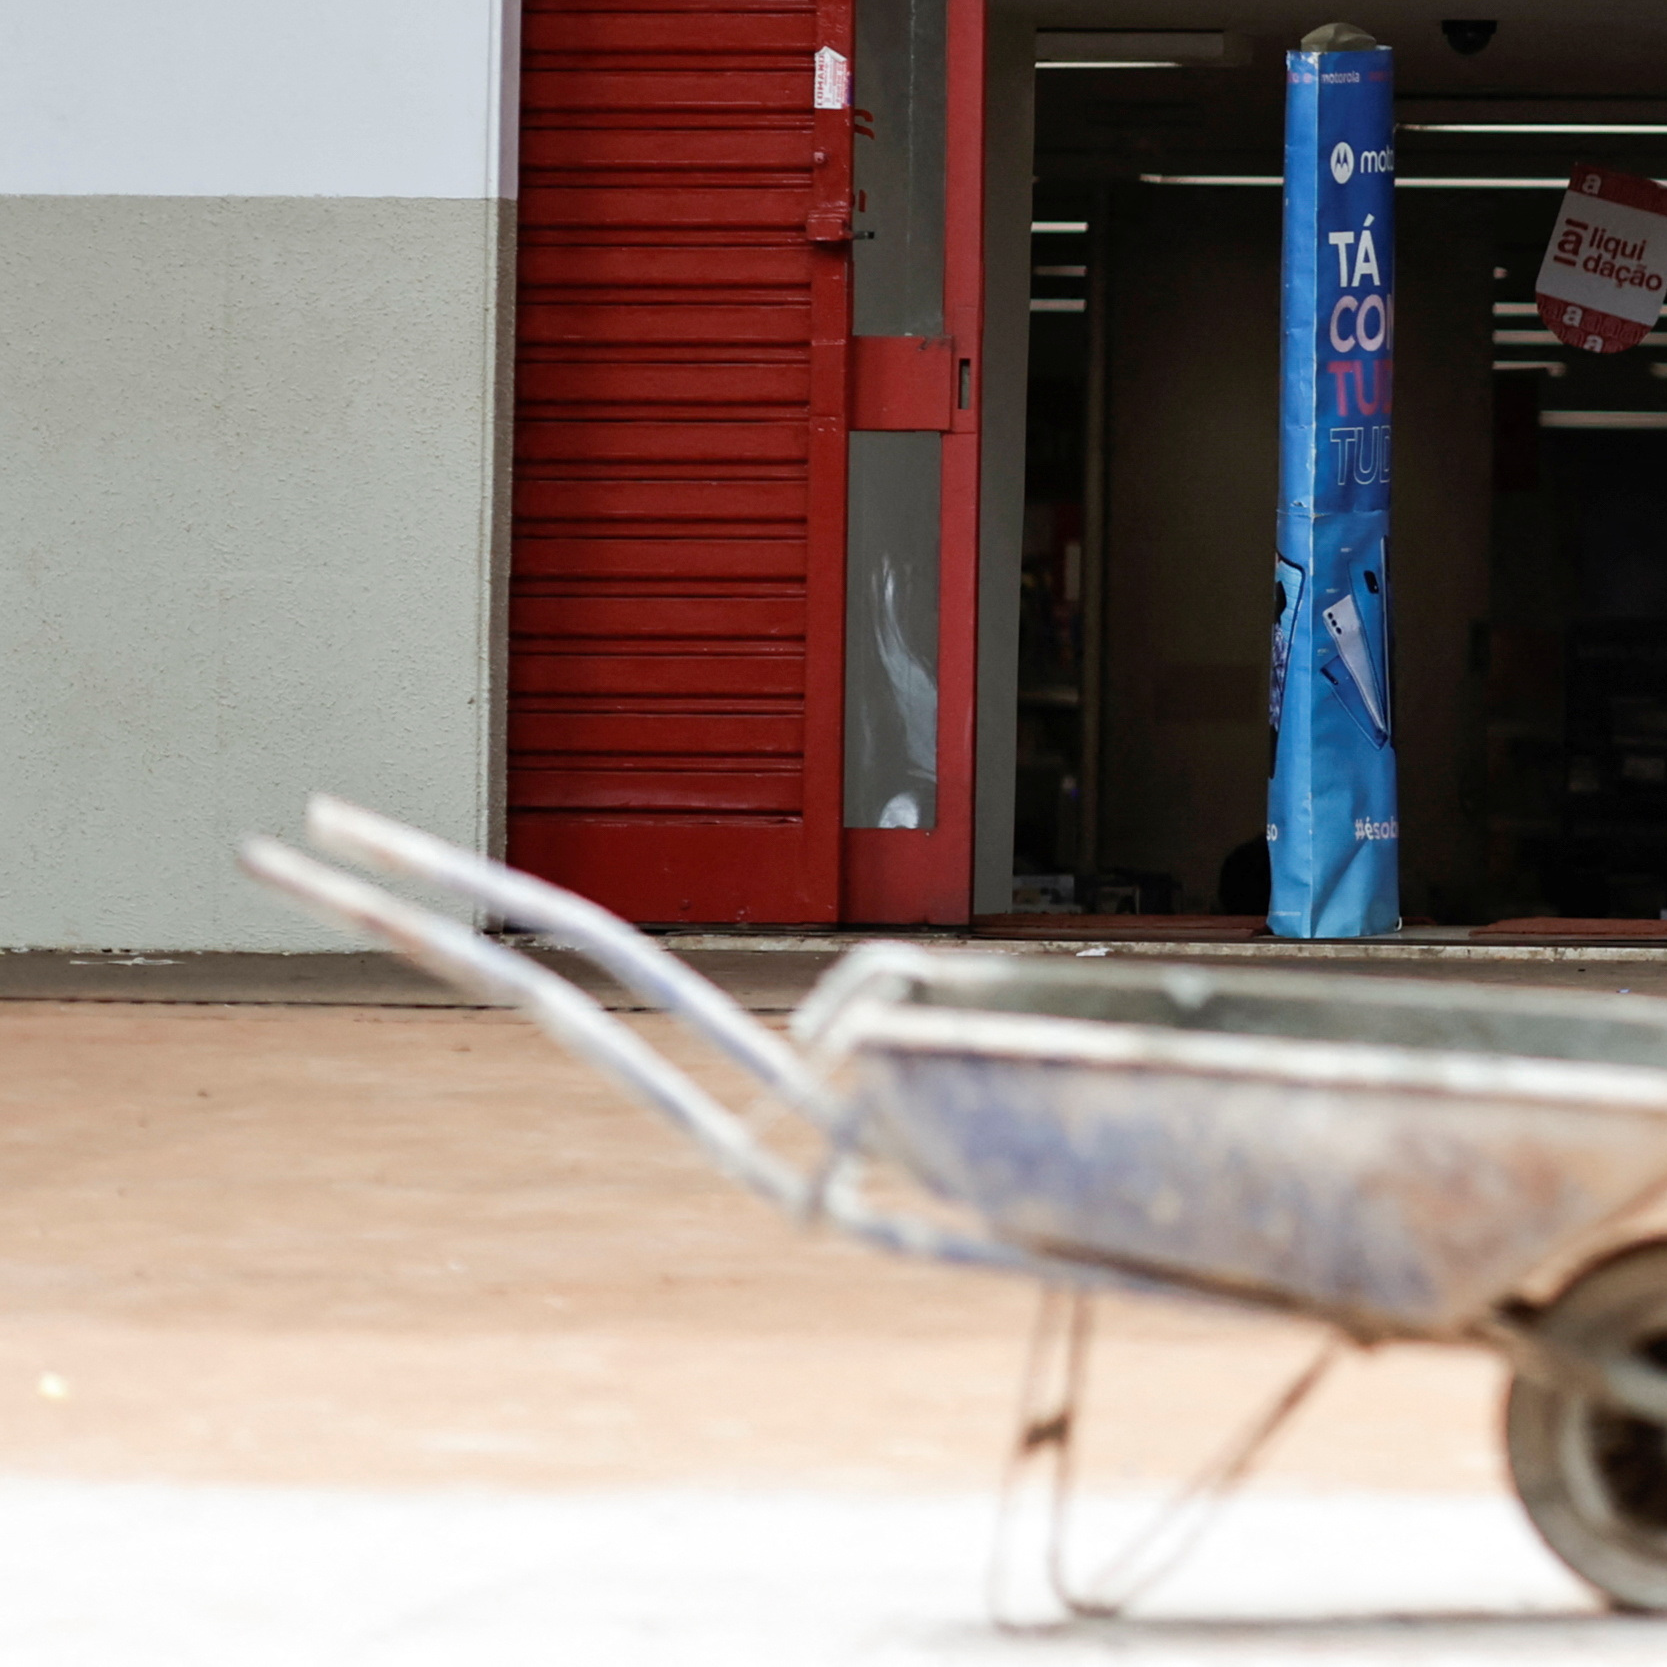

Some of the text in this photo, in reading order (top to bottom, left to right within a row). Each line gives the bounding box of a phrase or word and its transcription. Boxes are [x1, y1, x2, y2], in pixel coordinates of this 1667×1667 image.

[1321, 70, 1360, 84] motorola
[1328, 213, 1381, 288] TÁ
[1588, 226, 1648, 261] liqui
[1582, 252, 1663, 292] dação
